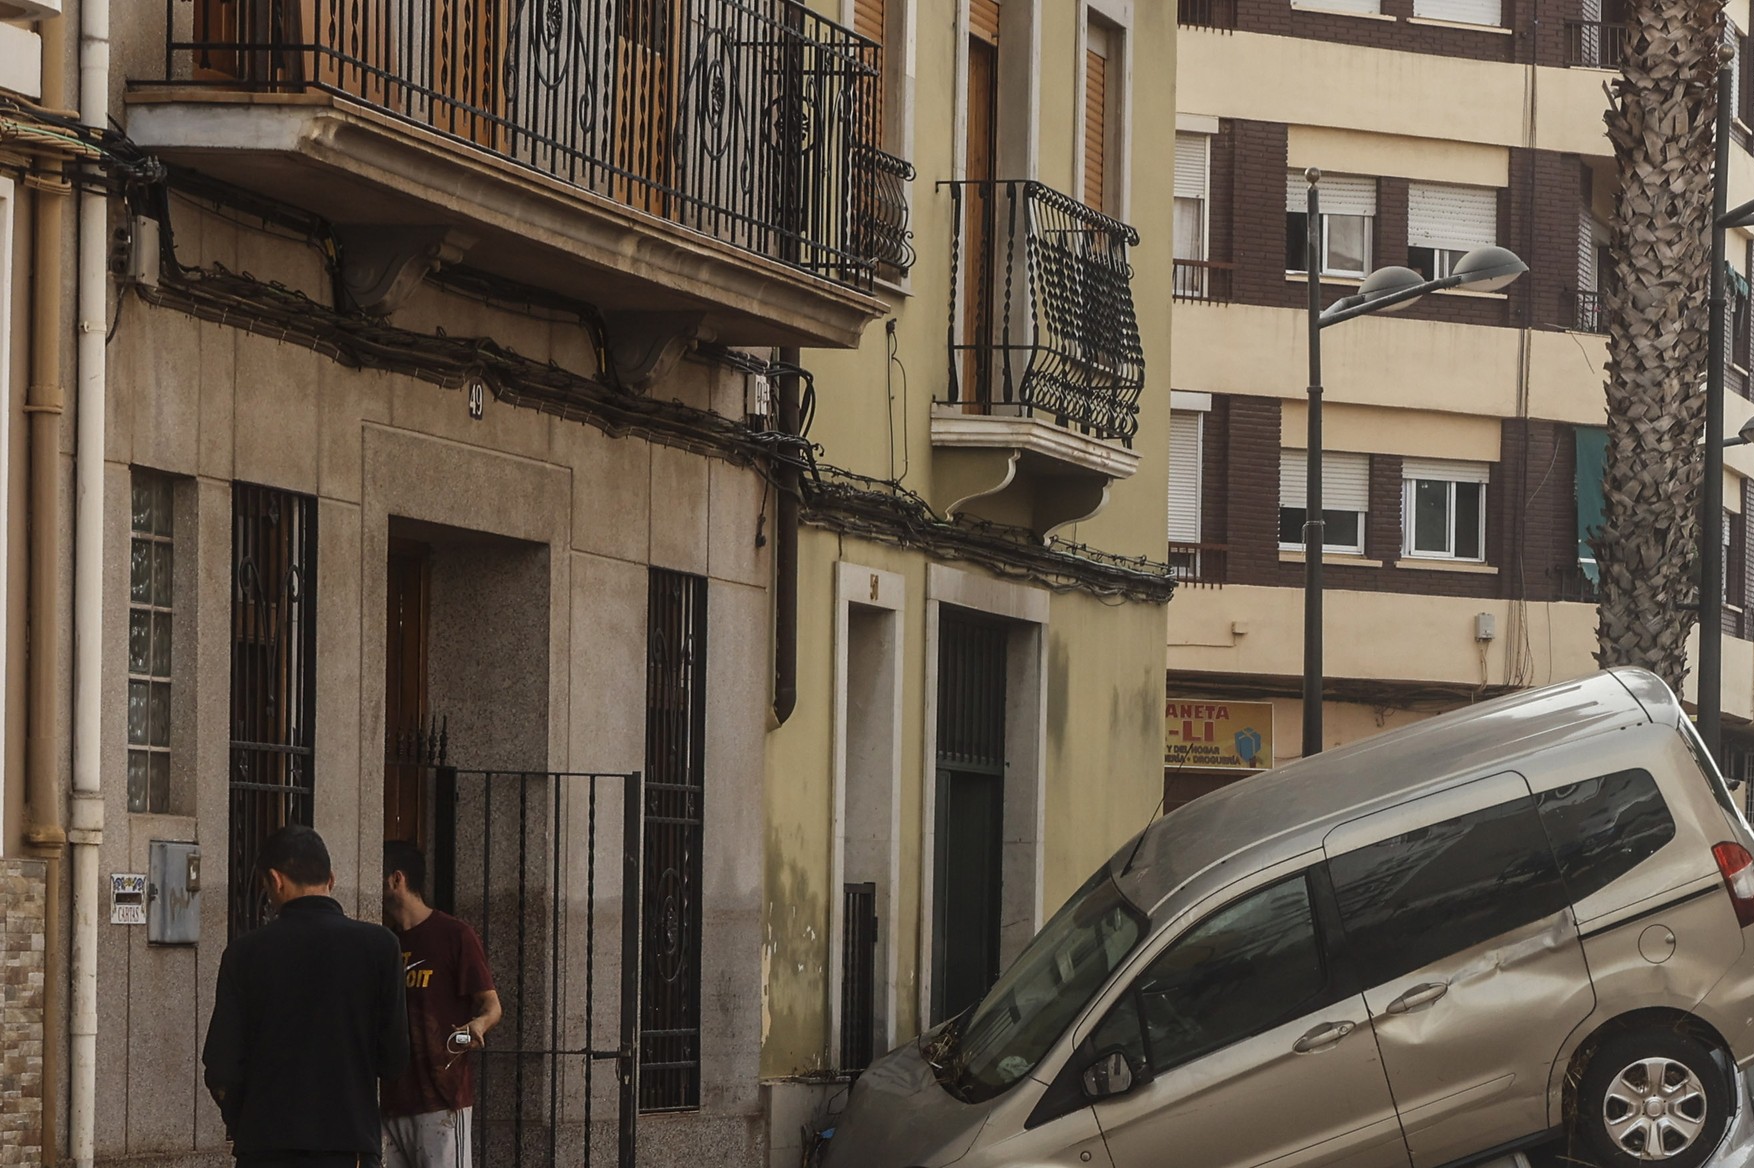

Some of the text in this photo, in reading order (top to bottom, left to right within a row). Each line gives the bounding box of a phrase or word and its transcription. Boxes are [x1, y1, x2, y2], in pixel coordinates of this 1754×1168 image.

[469, 384, 483, 415] 49
[1165, 720, 1214, 742] -LI
[117, 906, 140, 922] CARTAS
